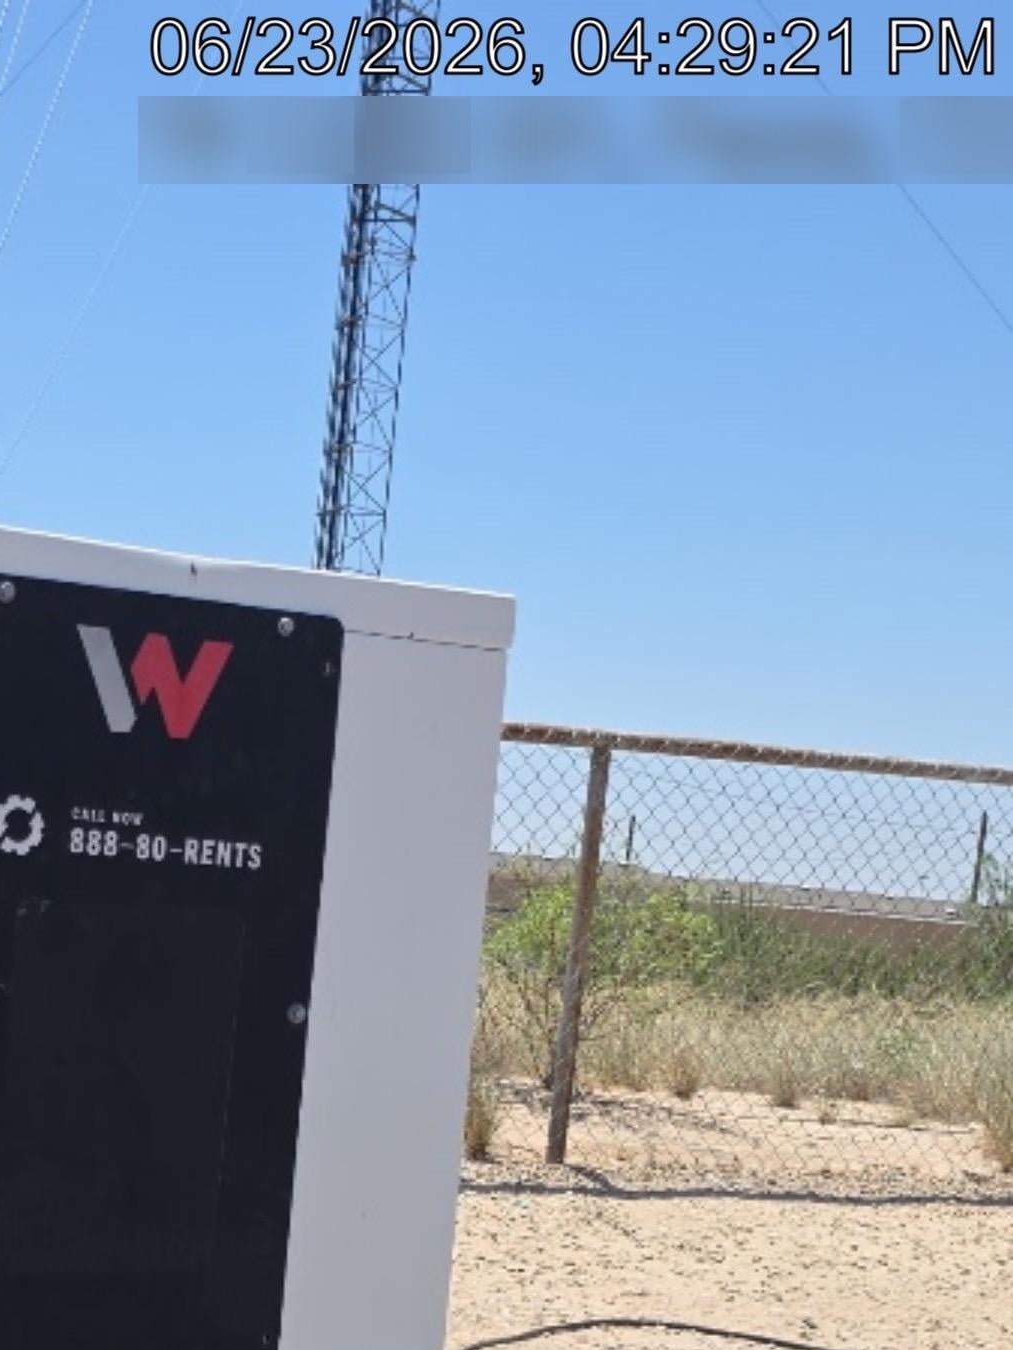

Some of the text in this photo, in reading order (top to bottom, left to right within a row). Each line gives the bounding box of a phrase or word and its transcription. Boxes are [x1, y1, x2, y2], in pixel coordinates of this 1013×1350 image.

[71, 806, 144, 827] CALL NOW
[69, 828, 262, 870] 888-80-RENTS
